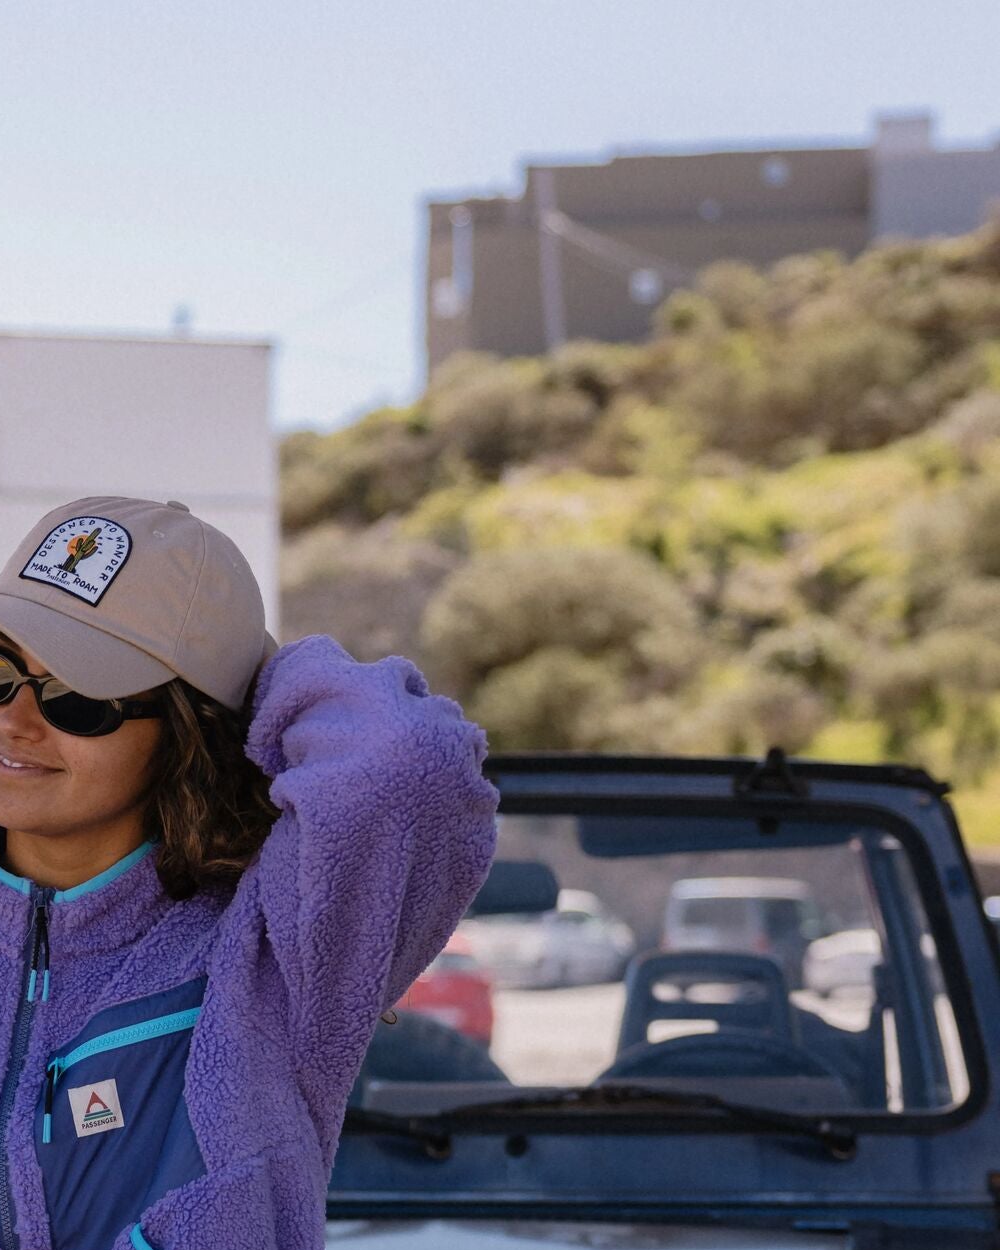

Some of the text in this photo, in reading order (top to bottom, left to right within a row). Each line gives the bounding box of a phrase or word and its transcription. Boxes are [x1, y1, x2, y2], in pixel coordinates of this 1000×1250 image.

[39, 520, 125, 581] DESIGNED TO WANDER
[31, 562, 98, 594] MADE TO ROAM
[82, 1116, 117, 1129] PASSENGER
